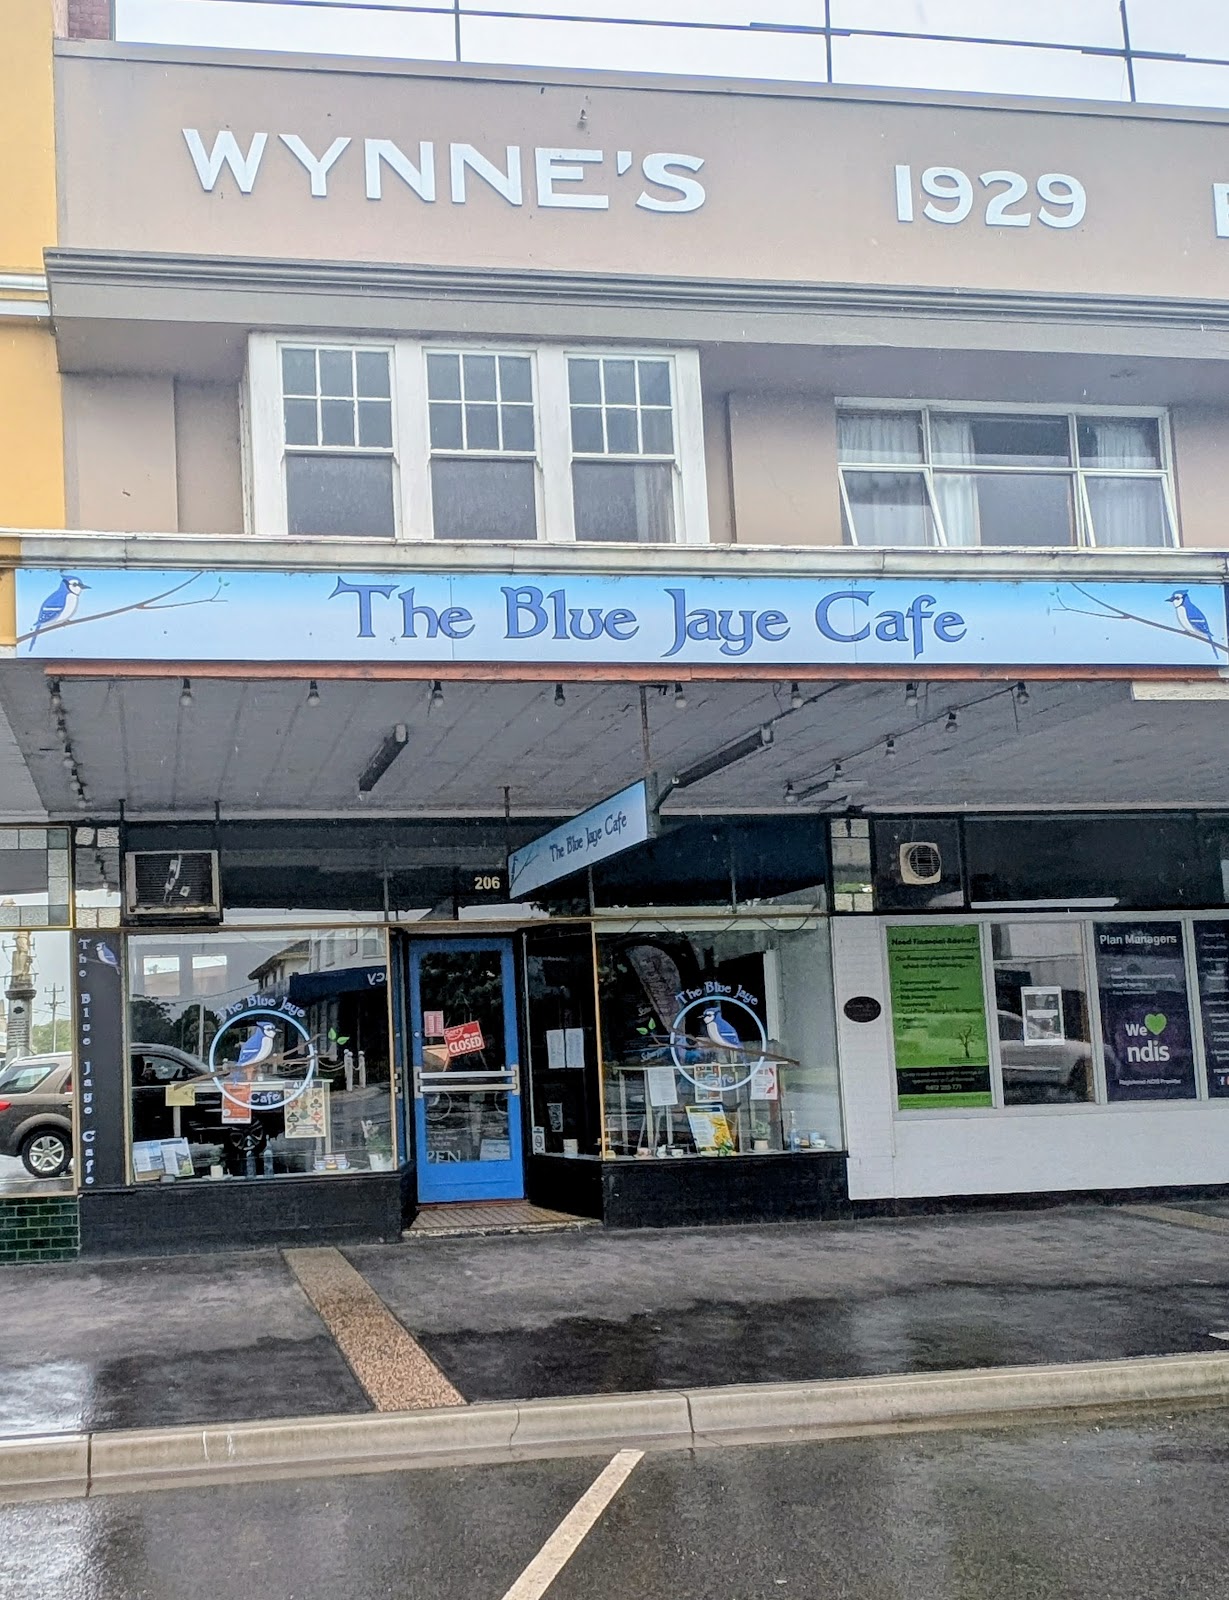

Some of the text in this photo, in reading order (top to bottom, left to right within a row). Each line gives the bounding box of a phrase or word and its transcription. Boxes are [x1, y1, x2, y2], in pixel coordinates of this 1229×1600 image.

[182, 128, 1087, 229] WYNNE'S 1929
[328, 576, 968, 660] The Blue Jaye Cafe
[550, 810, 628, 862] The Blue Jaye Cafe
[474, 876, 501, 890] 206
[1099, 934, 1177, 946] Plan Managers
[675, 980, 759, 1006] The Blue Jaye
[214, 994, 307, 1021] The Blue Jaye
[1125, 1023, 1148, 1037] We
[449, 1036, 482, 1053] CLOSED
[1126, 1040, 1171, 1062] ndis
[249, 1091, 282, 1104] Cafe
